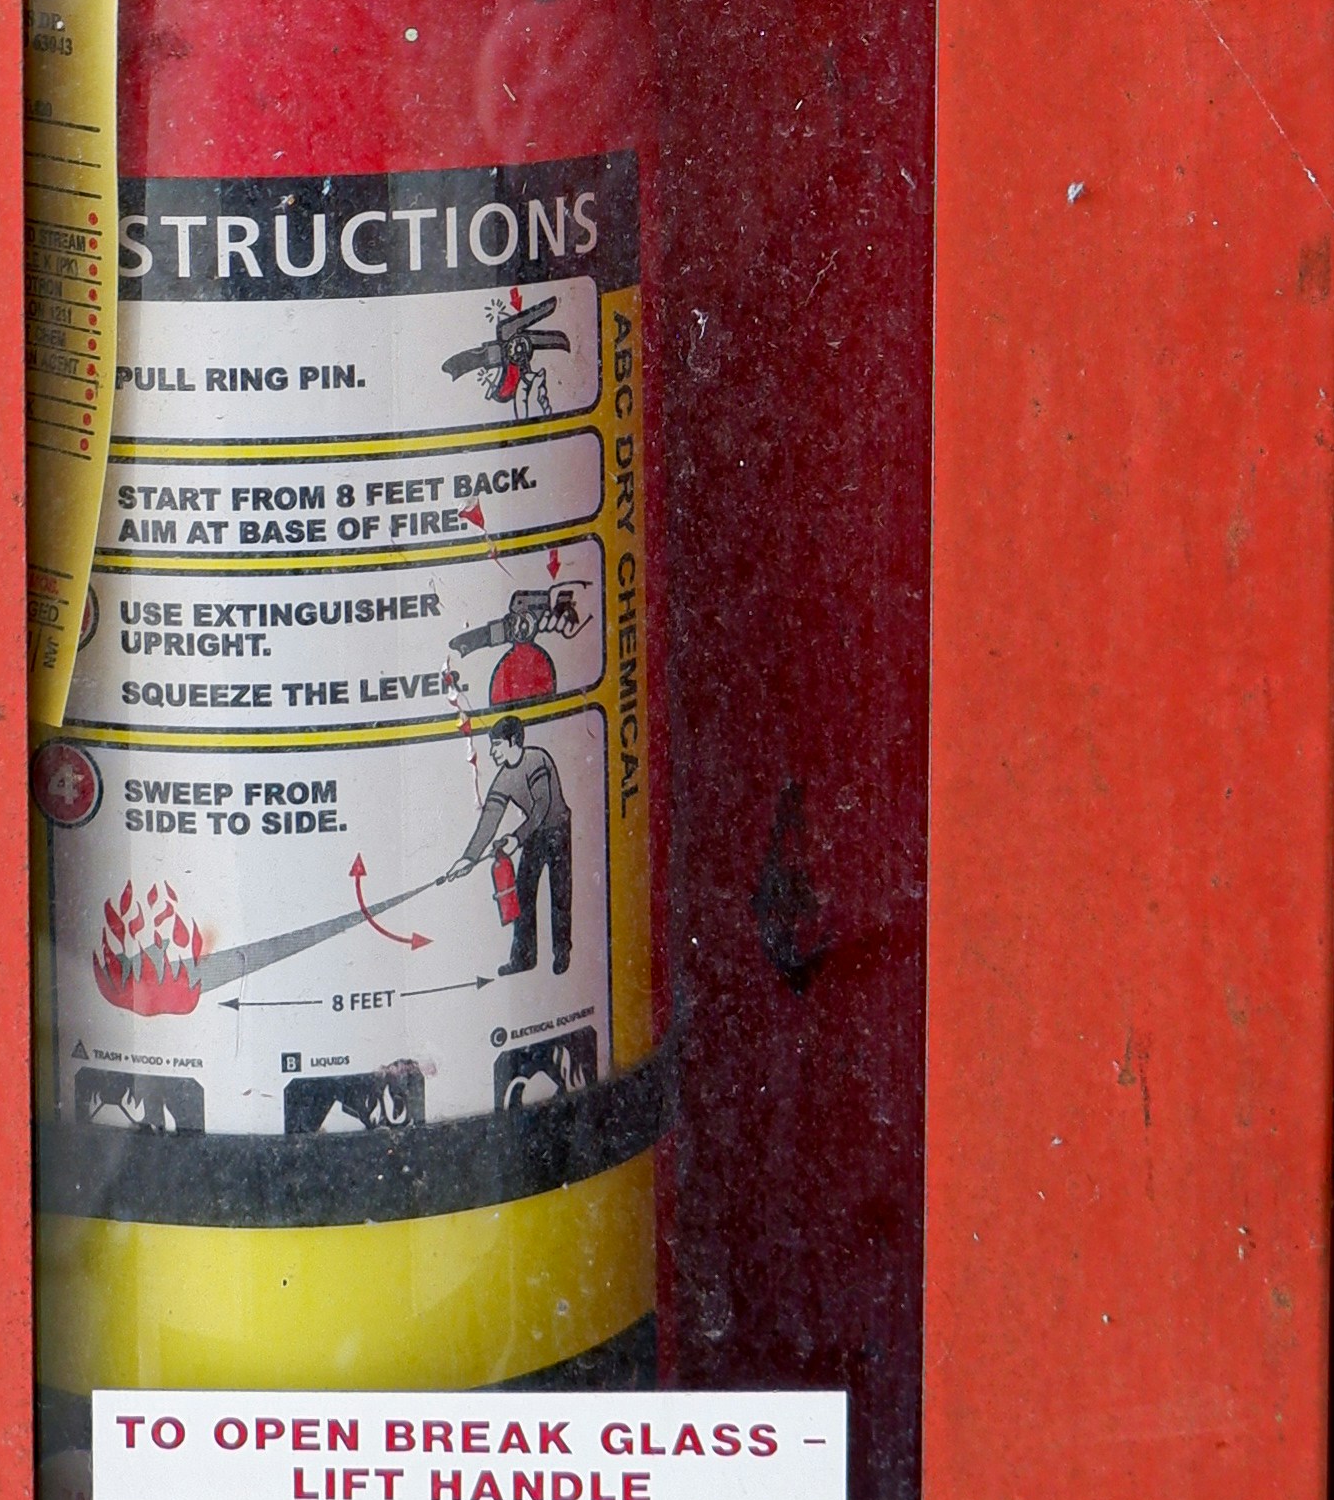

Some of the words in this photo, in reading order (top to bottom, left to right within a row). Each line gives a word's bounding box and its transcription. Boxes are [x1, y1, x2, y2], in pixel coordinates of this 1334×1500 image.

[40, 229, 86, 252] STREAM
[119, 192, 598, 279] STRUCTIONS
[115, 366, 196, 391] PULL
[206, 366, 288, 391] RING
[300, 364, 366, 390] PIN.
[613, 310, 634, 420] ABC
[118, 485, 222, 512] START
[231, 485, 325, 512] FROM
[335, 483, 355, 508] 8
[366, 477, 444, 507] FEET
[453, 466, 537, 500] BACK.
[615, 435, 636, 534] DRY
[118, 520, 177, 544] AIM
[185, 520, 229, 544] AT
[240, 518, 325, 544] BASE
[336, 514, 379, 541] OF
[391, 509, 468, 537] FIRE.
[120, 601, 183, 627] USE
[193, 594, 441, 629] EXTINGUISHER
[120, 632, 271, 657] UPRIGHT.
[121, 680, 272, 709] SQUEEZE
[282, 678, 351, 705] THE
[360, 671, 469, 702] LEVER.
[617, 552, 639, 819] CHEMICAL
[124, 779, 232, 805] SWEEP
[244, 780, 337, 806] FROM
[125, 808, 196, 835] SIDE
[206, 810, 251, 836] TO
[261, 809, 348, 835] SIDE.
[331, 992, 345, 1012] 8
[350, 989, 396, 1011] FEET
[510, 1021, 555, 1039] ELECTRICAL
[556, 1006, 595, 1027] EQUIPMENT
[93, 1049, 122, 1063] TRASH
[131, 1053, 163, 1066] WOOD
[173, 1057, 203, 1068] PAPER
[310, 1055, 350, 1067] LIQUIDS
[115, 1416, 186, 1450] TO
[214, 1416, 359, 1452] OPEN
[385, 1419, 572, 1454] BREAK
[601, 1422, 779, 1457] GLASS
